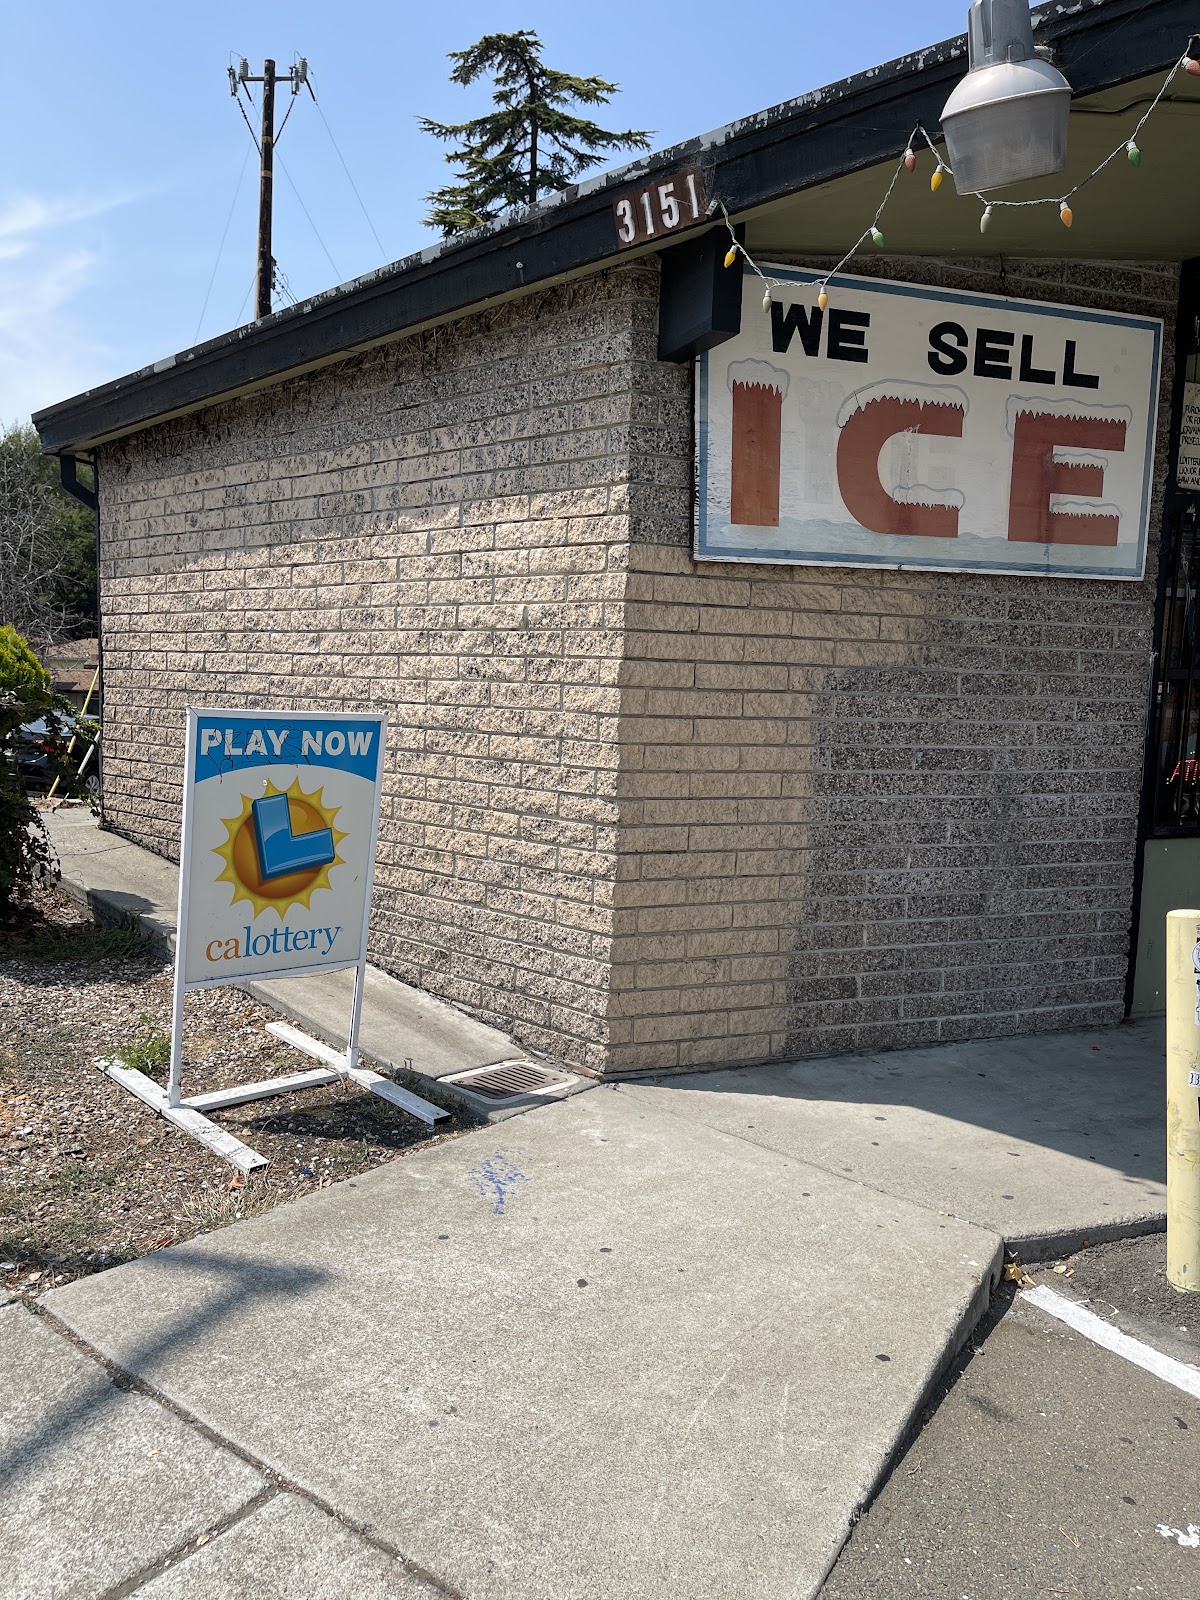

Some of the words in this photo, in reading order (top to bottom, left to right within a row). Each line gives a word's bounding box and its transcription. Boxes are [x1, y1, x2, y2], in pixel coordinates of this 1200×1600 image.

[617, 174, 699, 243] 3151
[769, 301, 871, 364] WE
[927, 321, 1100, 389] SELL
[729, 371, 1130, 547] ICE
[201, 728, 289, 756] PLAY
[301, 730, 373, 756] NOW
[205, 926, 342, 962] calottery
